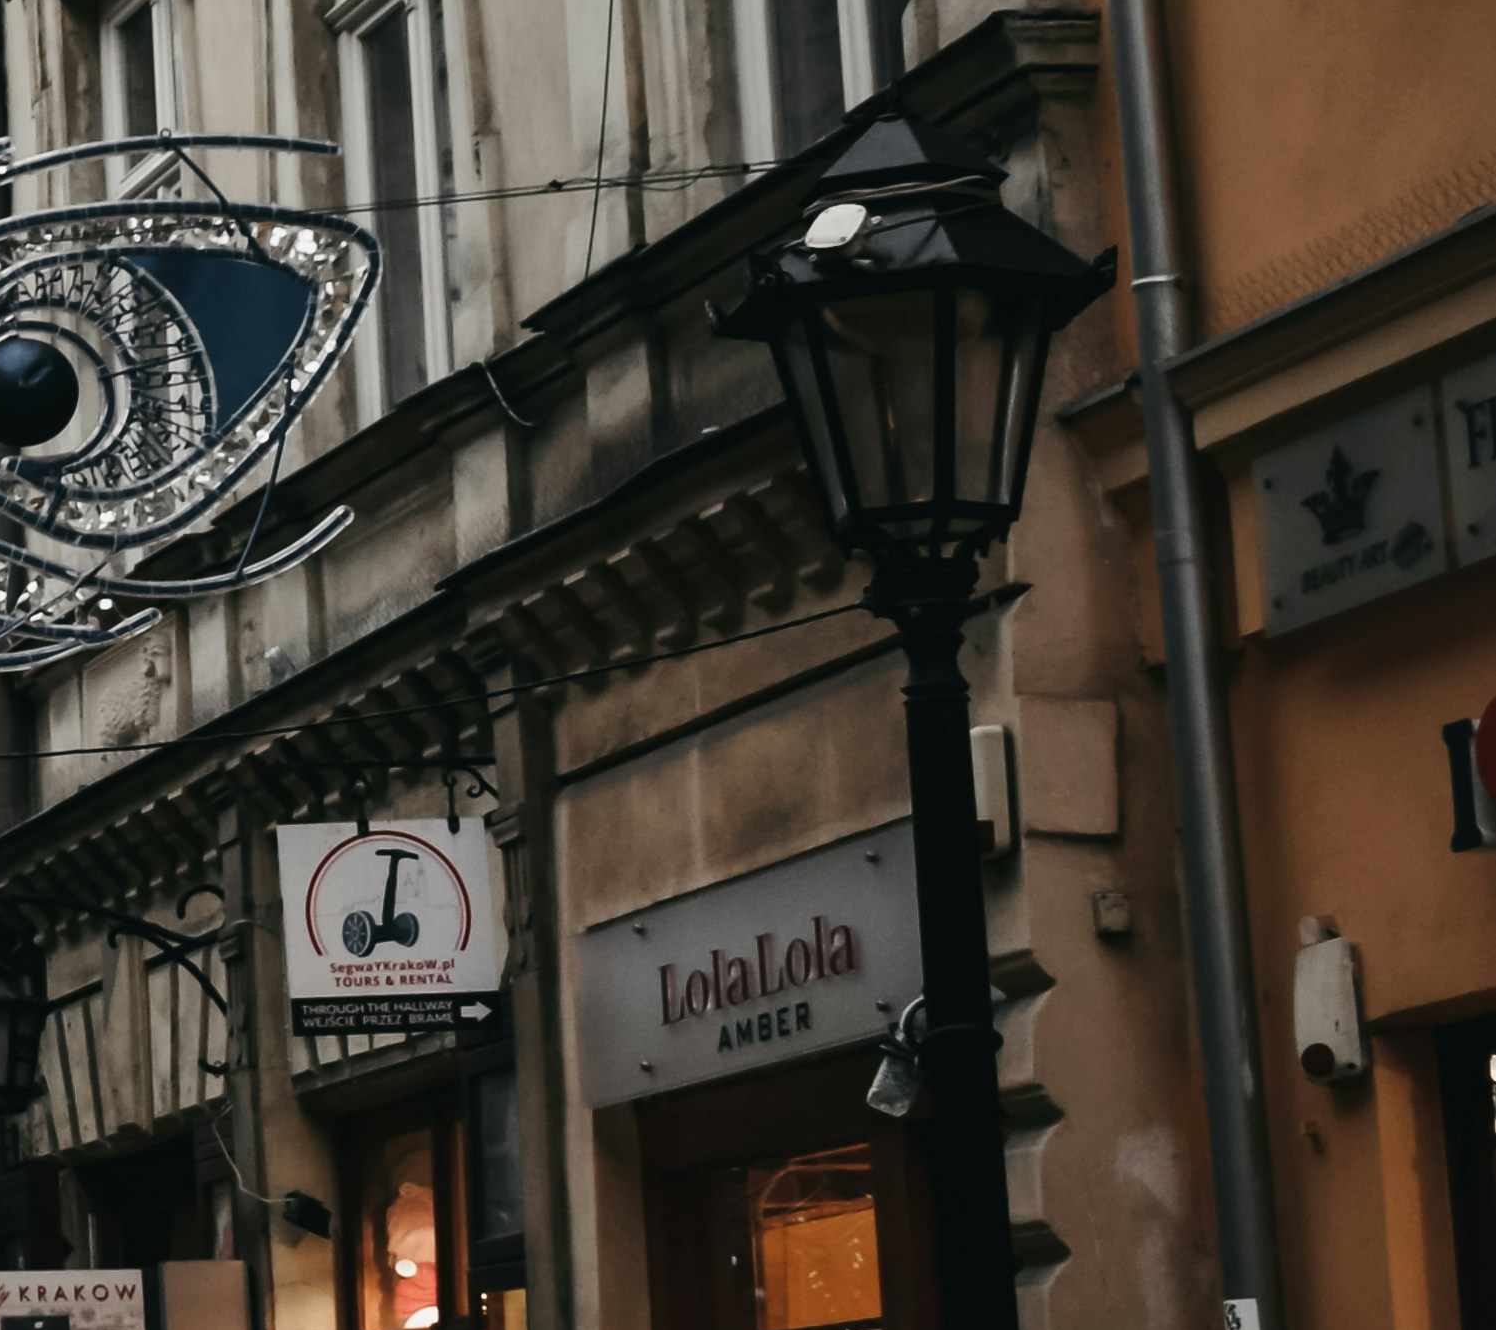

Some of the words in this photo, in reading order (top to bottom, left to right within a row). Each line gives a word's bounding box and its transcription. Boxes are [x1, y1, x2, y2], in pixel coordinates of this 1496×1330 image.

[334, 975, 380, 988] TOURS
[385, 975, 394, 986] &
[400, 973, 453, 985] RENTAL
[302, 1004, 364, 1015] THROUGH
[368, 1002, 391, 1013] THE
[394, 1000, 453, 1012] HALLWAY
[363, 1014, 402, 1025] PRZEZ
[718, 1002, 811, 1052] AMBER
[18, 1283, 137, 1302] KRAKOW
